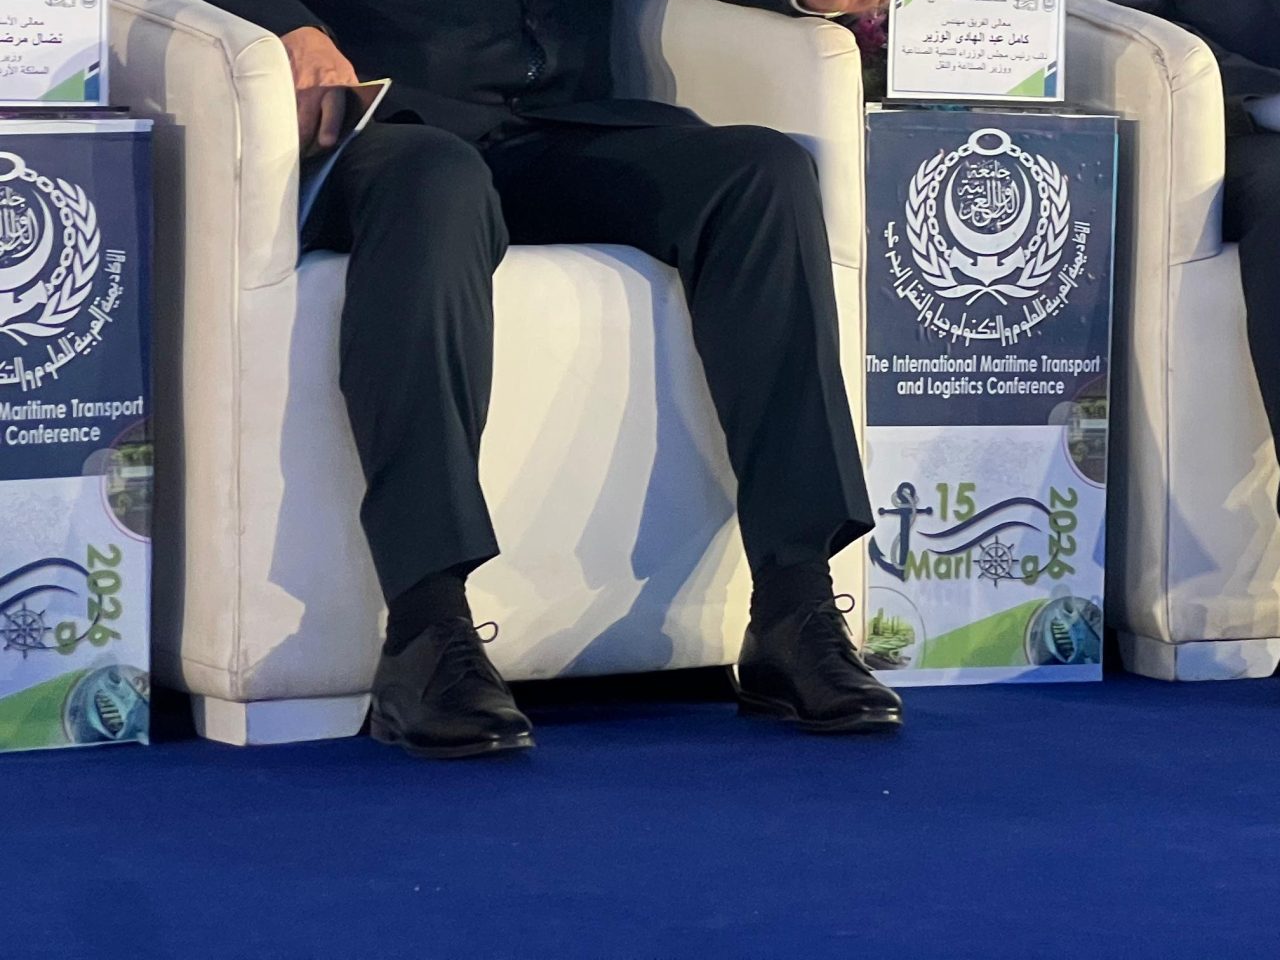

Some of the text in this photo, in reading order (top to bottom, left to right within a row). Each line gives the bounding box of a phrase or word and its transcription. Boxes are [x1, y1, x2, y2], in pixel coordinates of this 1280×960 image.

[0, 32, 28, 46] مرض
[922, 30, 951, 44] الوزير
[989, 35, 1004, 44] عبد
[1008, 34, 1030, 46] كامل
[866, 354, 1100, 376] The International Maritime Transport
[897, 376, 1065, 399] and Logistics Conference
[0, 396, 144, 421] Maritime Transport
[5, 424, 101, 445] Conference
[936, 482, 977, 522] 15
[1048, 486, 1079, 580] 2026
[87, 543, 122, 648] 2026
